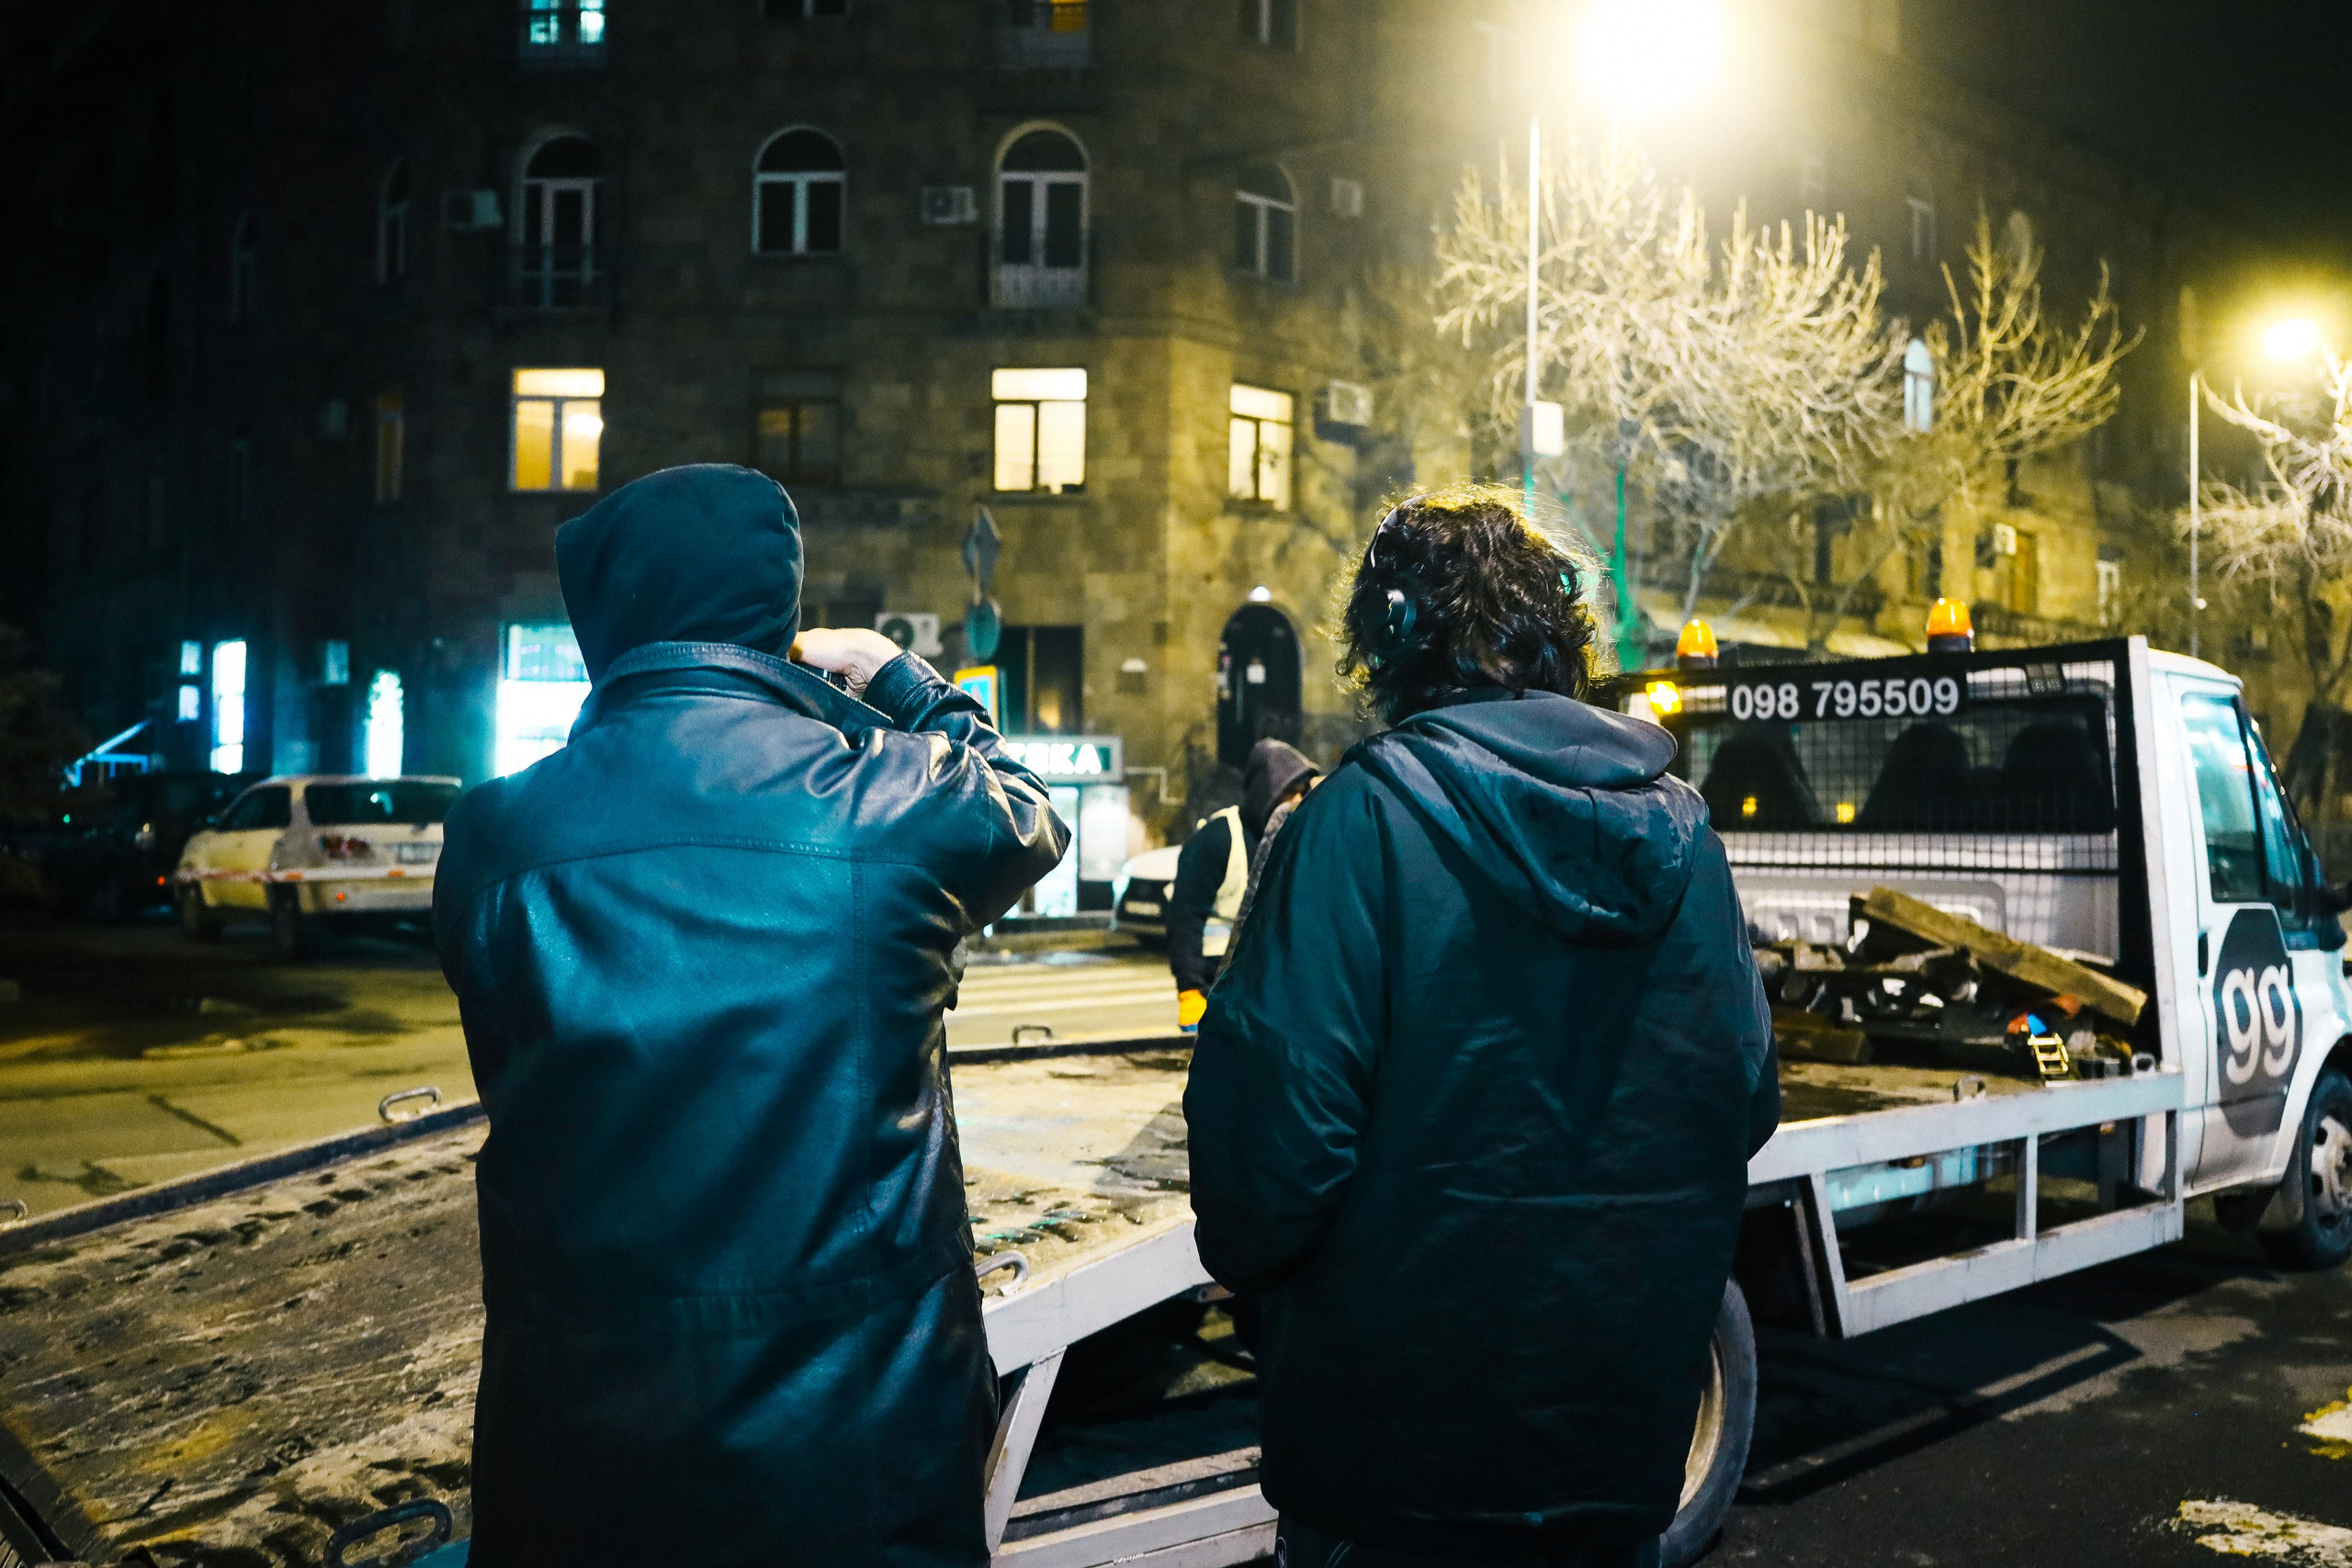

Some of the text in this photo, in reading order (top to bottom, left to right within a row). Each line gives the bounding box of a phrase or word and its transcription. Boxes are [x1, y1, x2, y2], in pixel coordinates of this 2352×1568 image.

[1732, 677, 1959, 720] 098 795509
[2222, 964, 2295, 1084] gg
